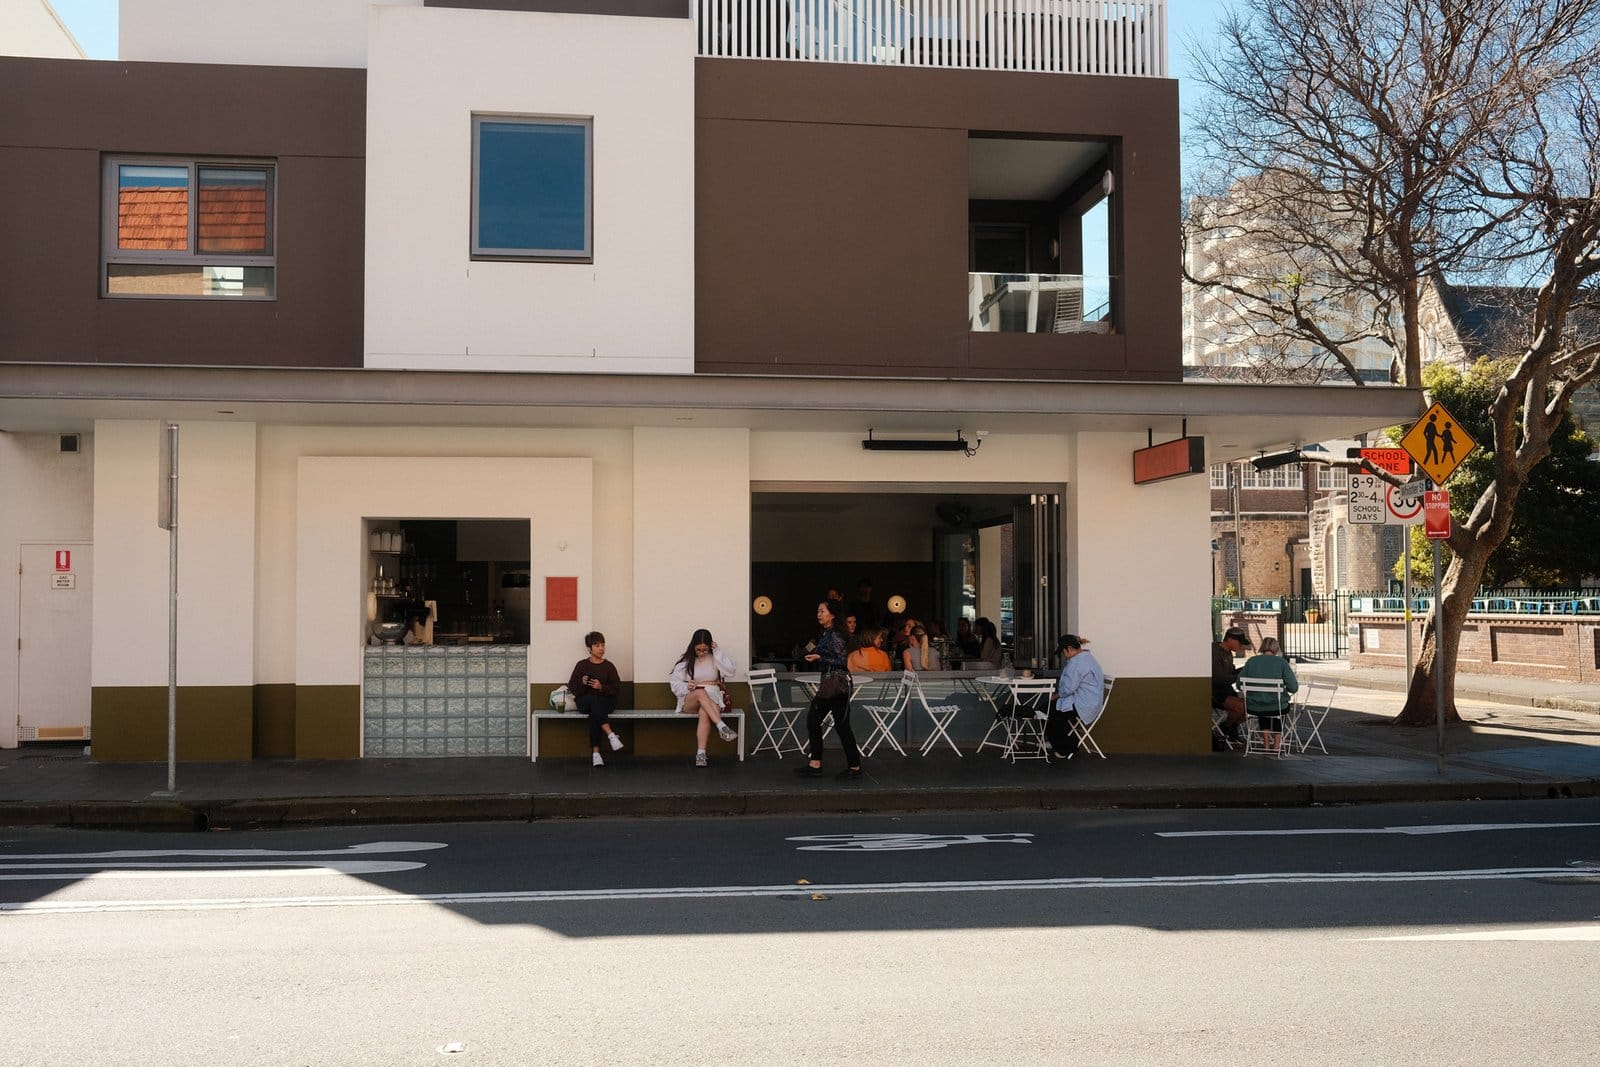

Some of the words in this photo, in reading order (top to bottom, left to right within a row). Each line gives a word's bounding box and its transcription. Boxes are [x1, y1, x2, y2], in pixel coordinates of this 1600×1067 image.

[1364, 451, 1406, 461] SCHOOL
[1375, 462, 1400, 472] ONE
[1431, 493, 1442, 501] NO
